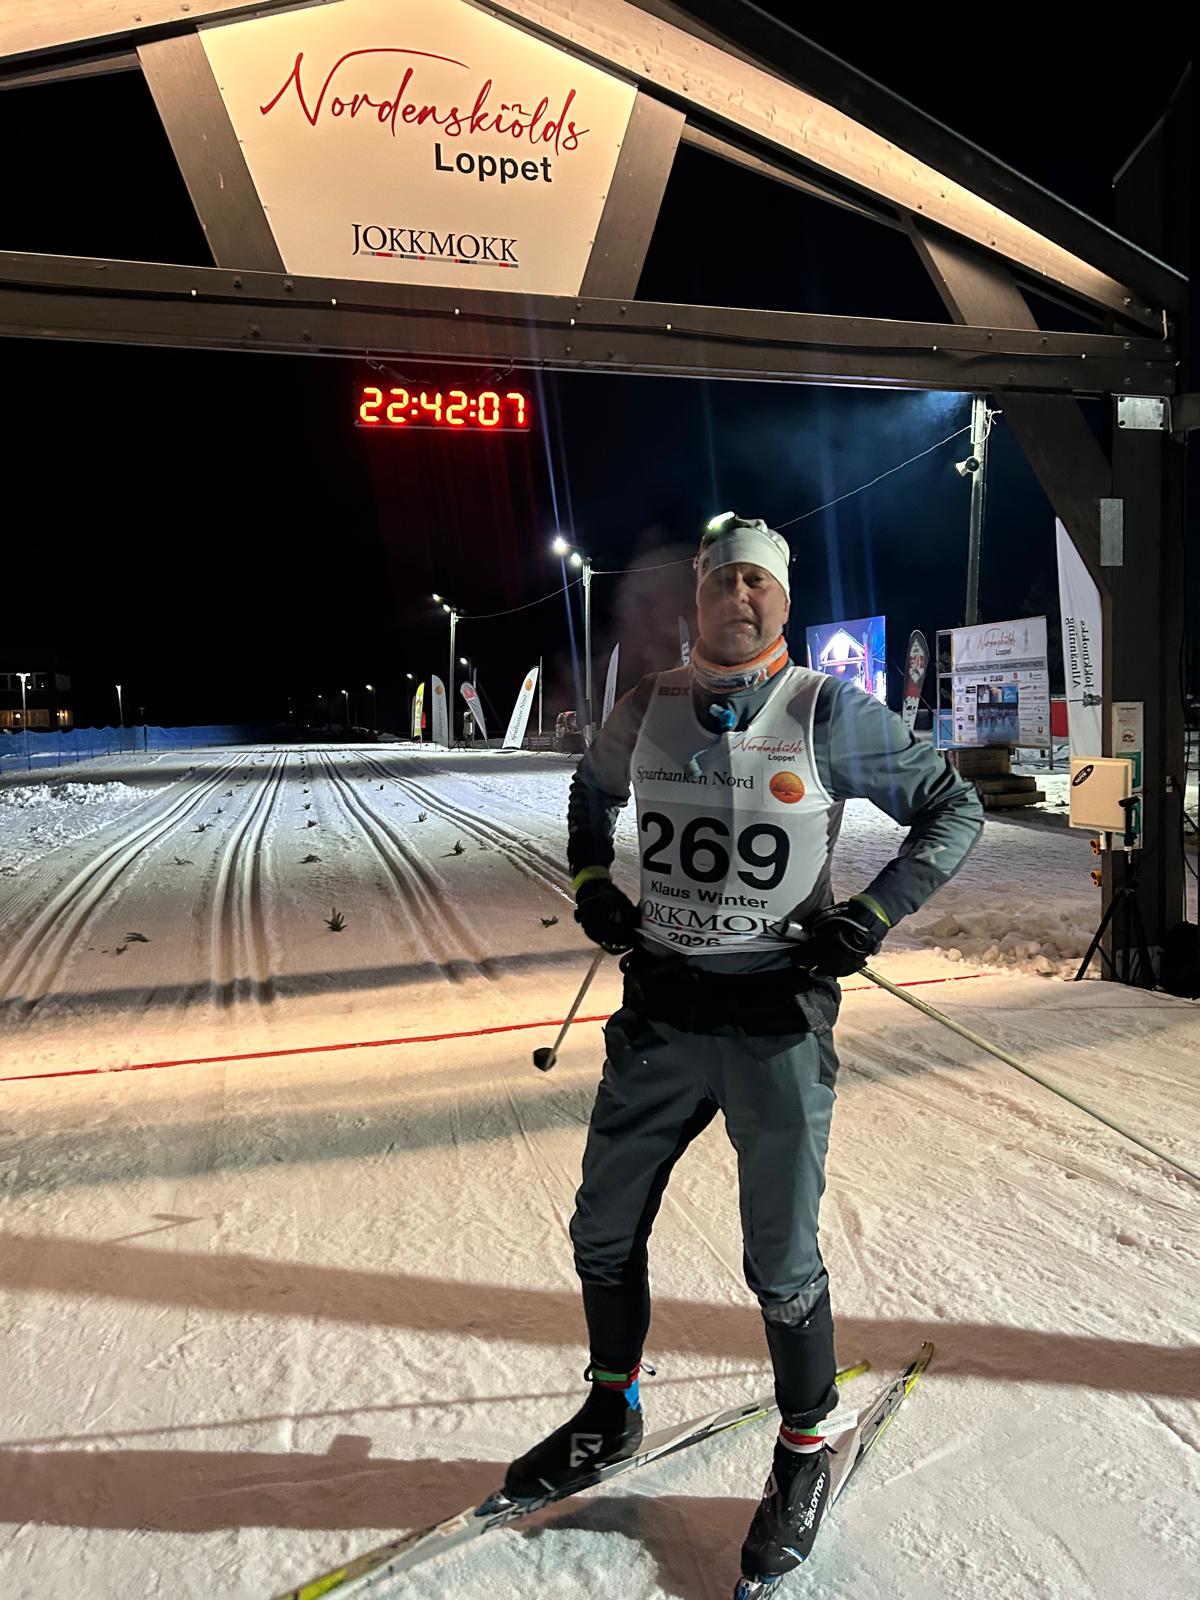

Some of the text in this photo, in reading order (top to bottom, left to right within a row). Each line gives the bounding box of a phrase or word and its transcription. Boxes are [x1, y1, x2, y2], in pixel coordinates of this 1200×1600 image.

[259, 48, 591, 156] Nordenskiölds
[433, 142, 553, 184] Loppet
[351, 223, 520, 263] JOKKMOKK
[359, 387, 525, 426] 22:42:07
[636, 766, 755, 789] Sparbankn Nord
[767, 754, 796, 762] Loppet
[641, 811, 791, 891] 269
[650, 880, 769, 909] Klaus Winter
[642, 900, 786, 937] OKKMOK
[667, 932, 721, 947] 2026
[804, 1472, 827, 1529] salomon
